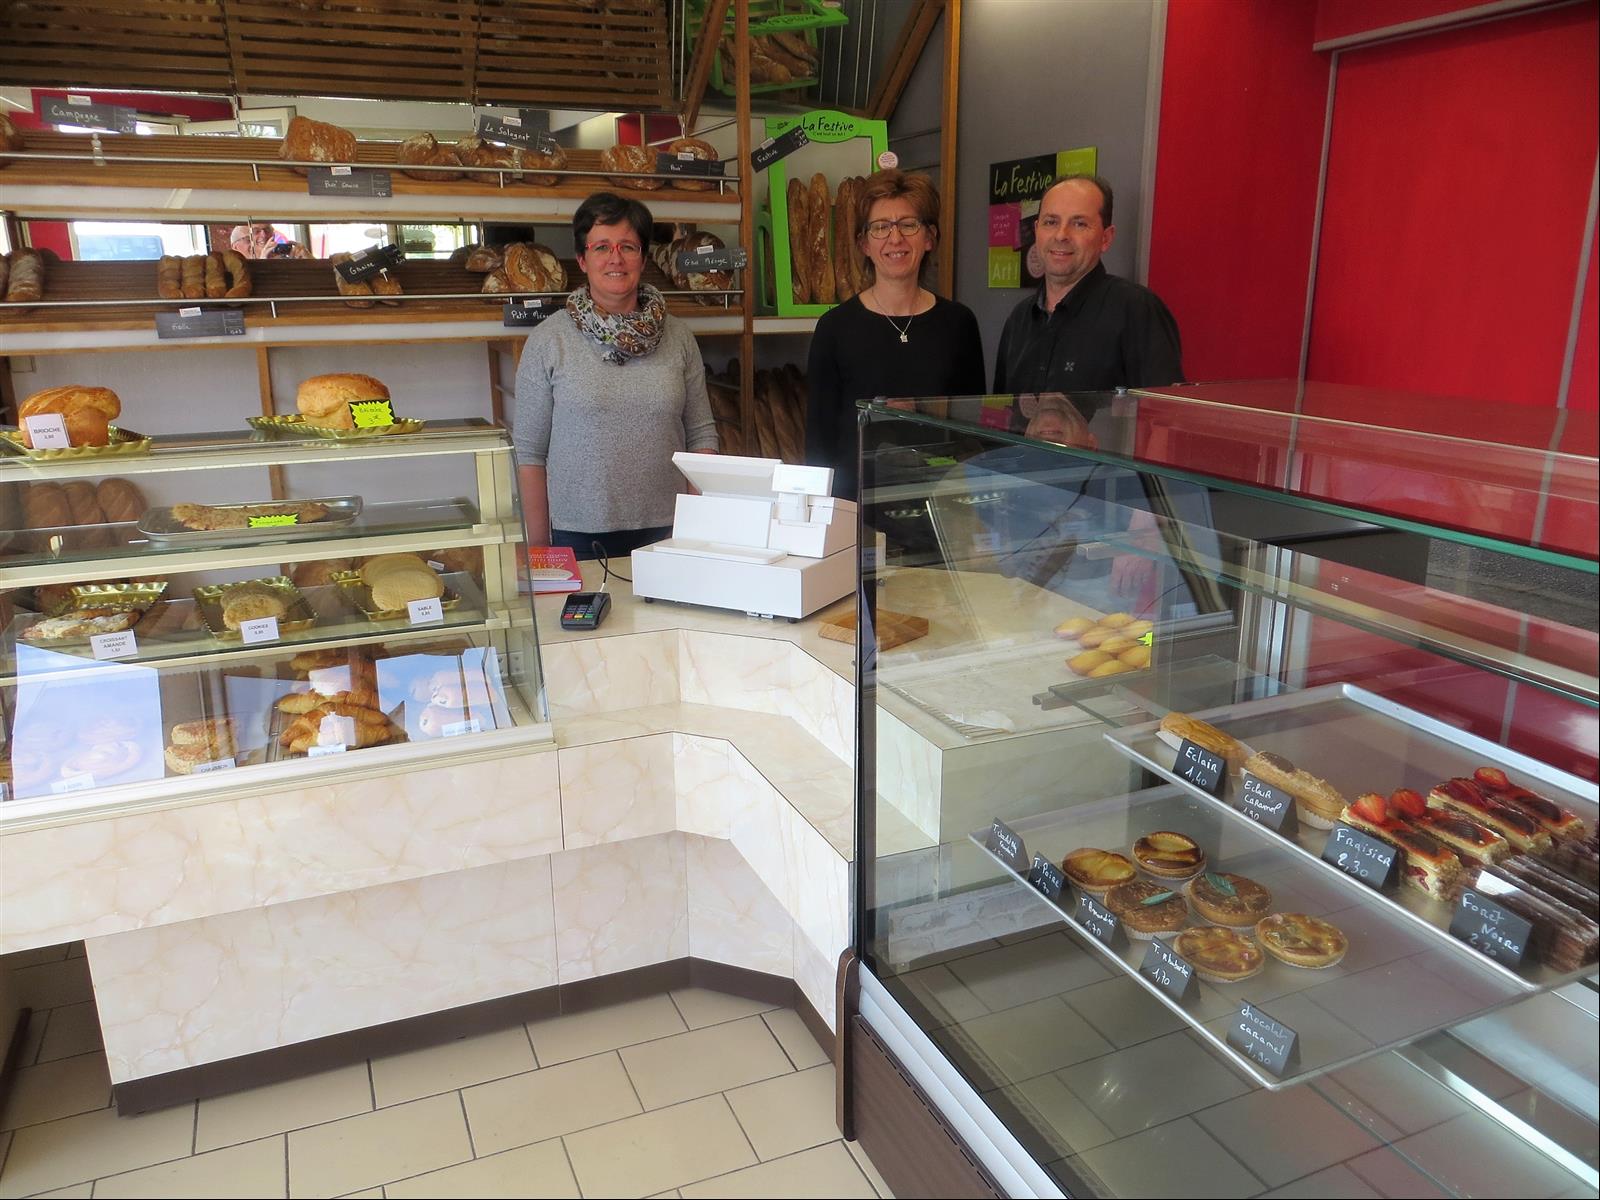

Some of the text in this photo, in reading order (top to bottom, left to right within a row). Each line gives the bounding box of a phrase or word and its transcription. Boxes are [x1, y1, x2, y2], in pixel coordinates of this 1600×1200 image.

[485, 122, 494, 132] Le
[802, 117, 815, 131] La
[818, 116, 854, 132] Festive
[994, 164, 1053, 197] La Festive
[992, 262, 1012, 281] Art
[511, 310, 528, 319] Petit
[100, 635, 128, 643] CROISSANT
[103, 641, 127, 649] AMANDE
[1185, 766, 1207, 786] 1,40
[1337, 853, 1369, 877] 2,30
[1152, 968, 1171, 986] 1,70
